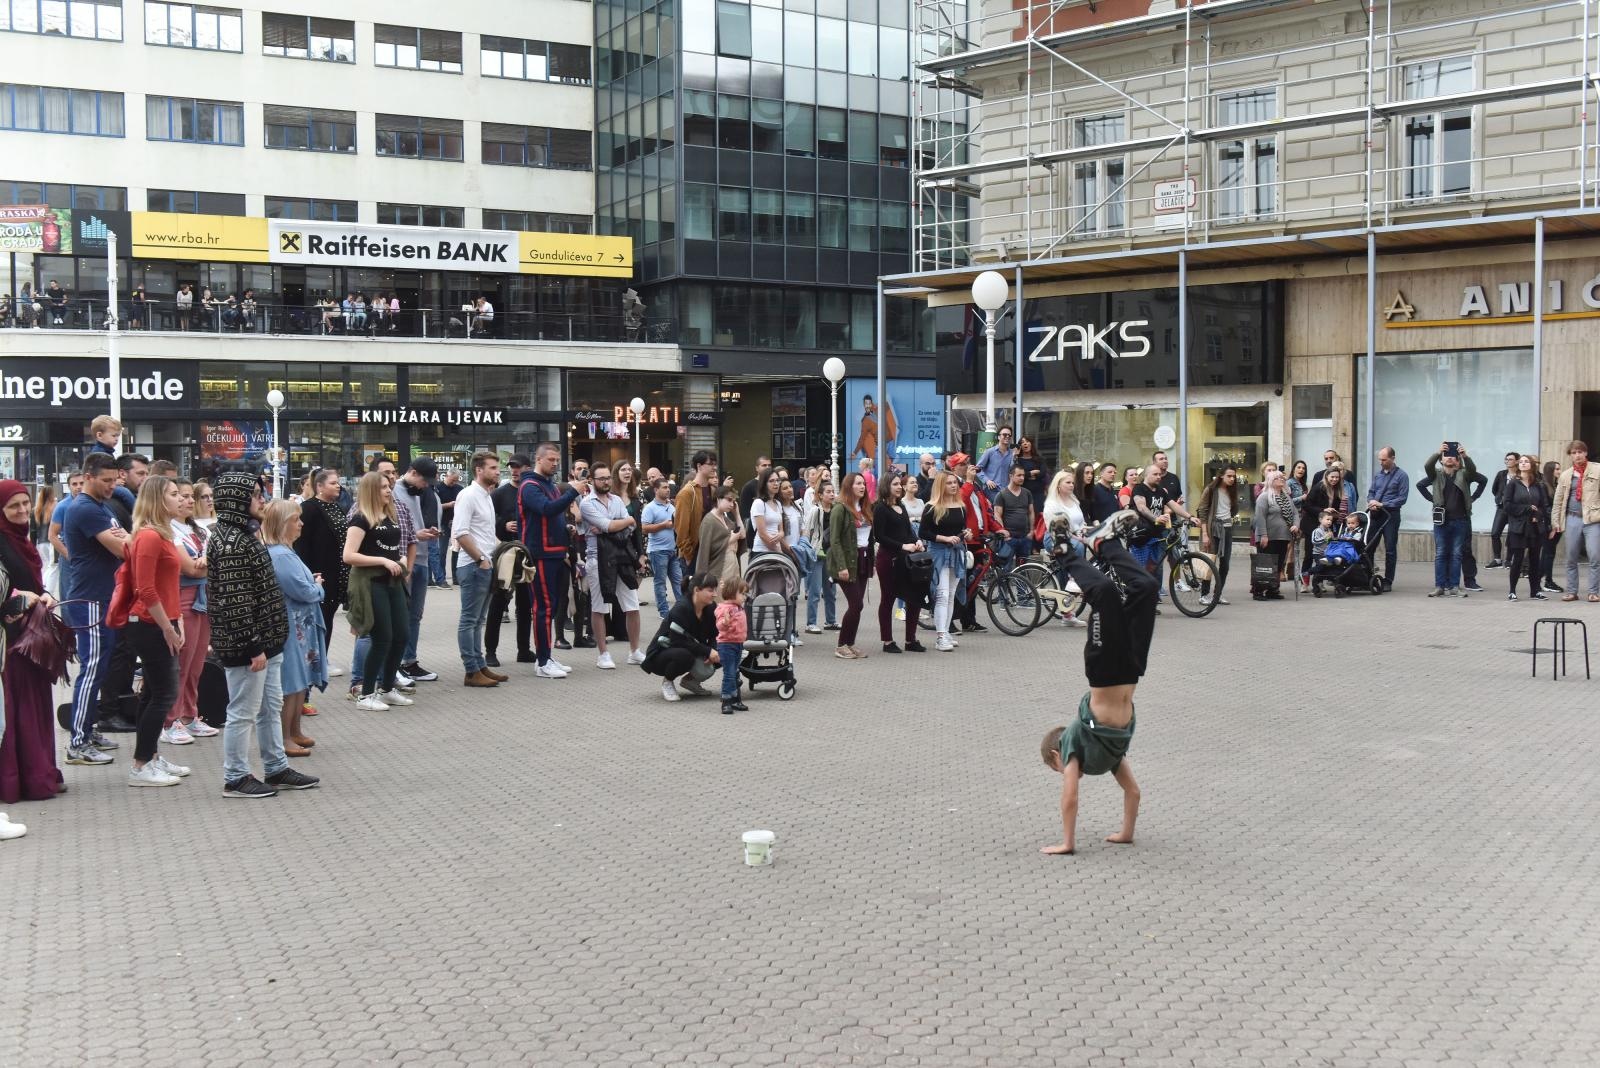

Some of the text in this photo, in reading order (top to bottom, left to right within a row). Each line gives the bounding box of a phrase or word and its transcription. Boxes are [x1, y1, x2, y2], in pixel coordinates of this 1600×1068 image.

[1161, 195, 1187, 207] JELAČIĆ
[145, 231, 220, 246] www.rba.hr
[308, 233, 509, 263] Raiffeisen BANK
[529, 249, 604, 263] Gundulićeva 7
[1027, 320, 1151, 362] ZAKS
[50, 371, 184, 406] ponude
[362, 406, 503, 424] KNJIŽARA LJEVAK
[614, 406, 679, 423] PELATI
[206, 432, 248, 443] OČEKUJUĆI
[809, 428, 844, 449] Erse
[918, 430, 940, 440] 0-24
